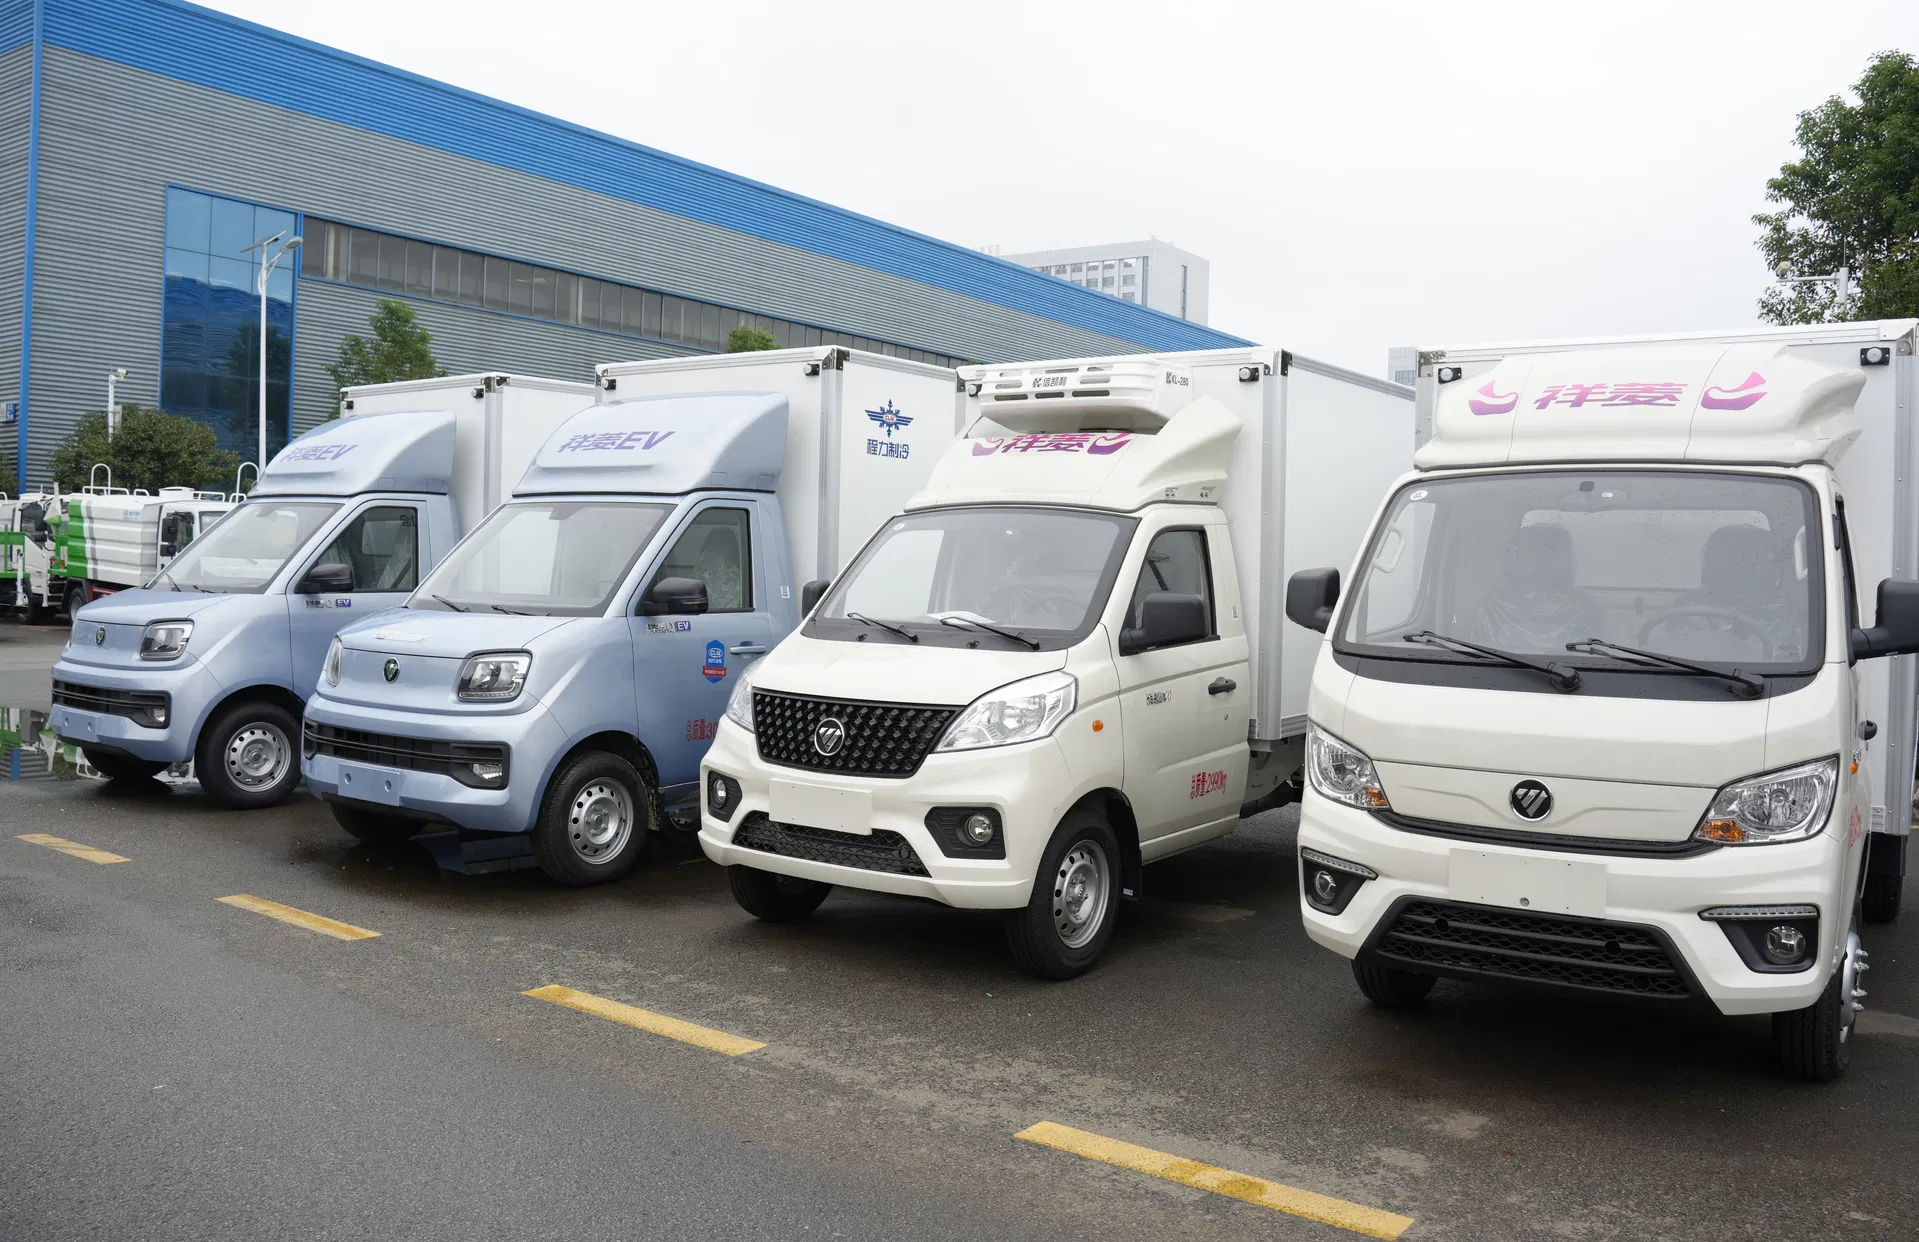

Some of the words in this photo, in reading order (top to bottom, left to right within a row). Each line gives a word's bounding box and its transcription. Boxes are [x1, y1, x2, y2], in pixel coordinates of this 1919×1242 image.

[1533, 382, 1688, 410] 祥菱
[866, 438, 910, 460] 程力制冷
[1001, 433, 1096, 453] 祥菱
[677, 622, 689, 630] EV
